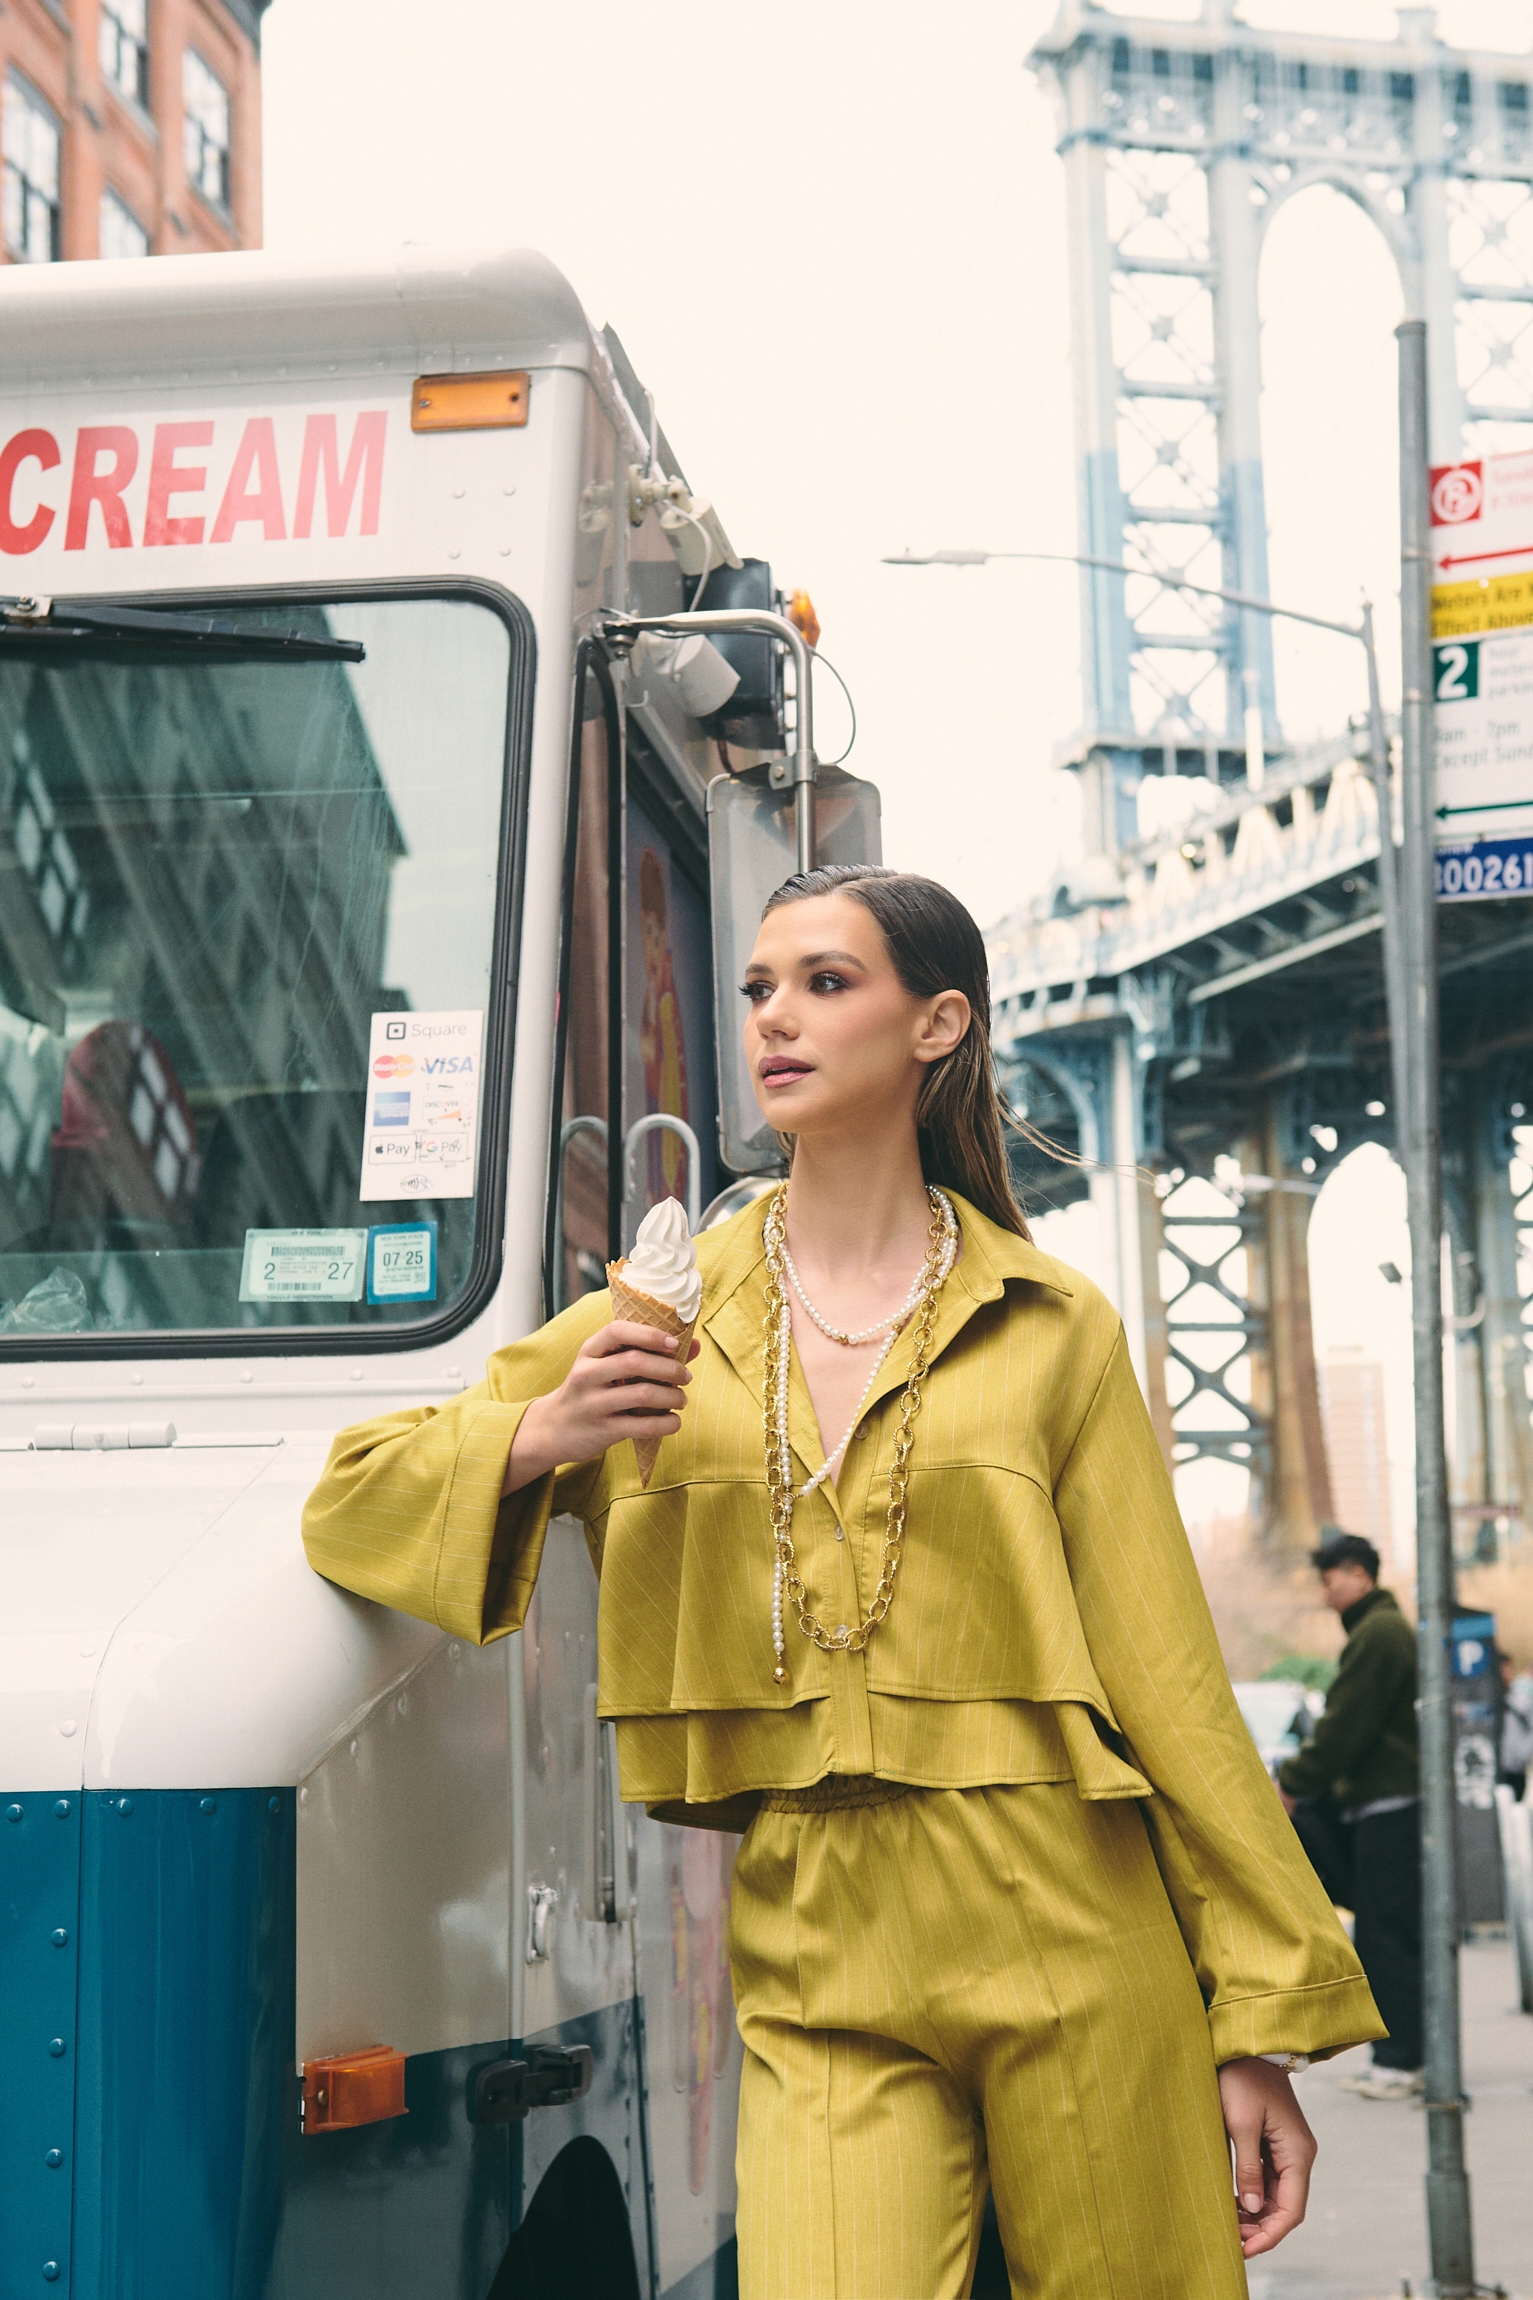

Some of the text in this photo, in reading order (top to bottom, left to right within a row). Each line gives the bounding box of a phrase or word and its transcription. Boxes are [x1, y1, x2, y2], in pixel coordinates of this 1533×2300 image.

[0, 410, 388, 556] CREAM
[1497, 586, 1522, 602] Are
[1437, 645, 1469, 699] 2
[411, 1024, 467, 1039] Square
[424, 1056, 473, 1075] VISA
[387, 1143, 410, 1156] Pay
[441, 1142, 462, 1155] Pay
[383, 1250, 423, 1267] 07 25
[263, 1262, 276, 1280] 2
[327, 1262, 354, 1280] 27
